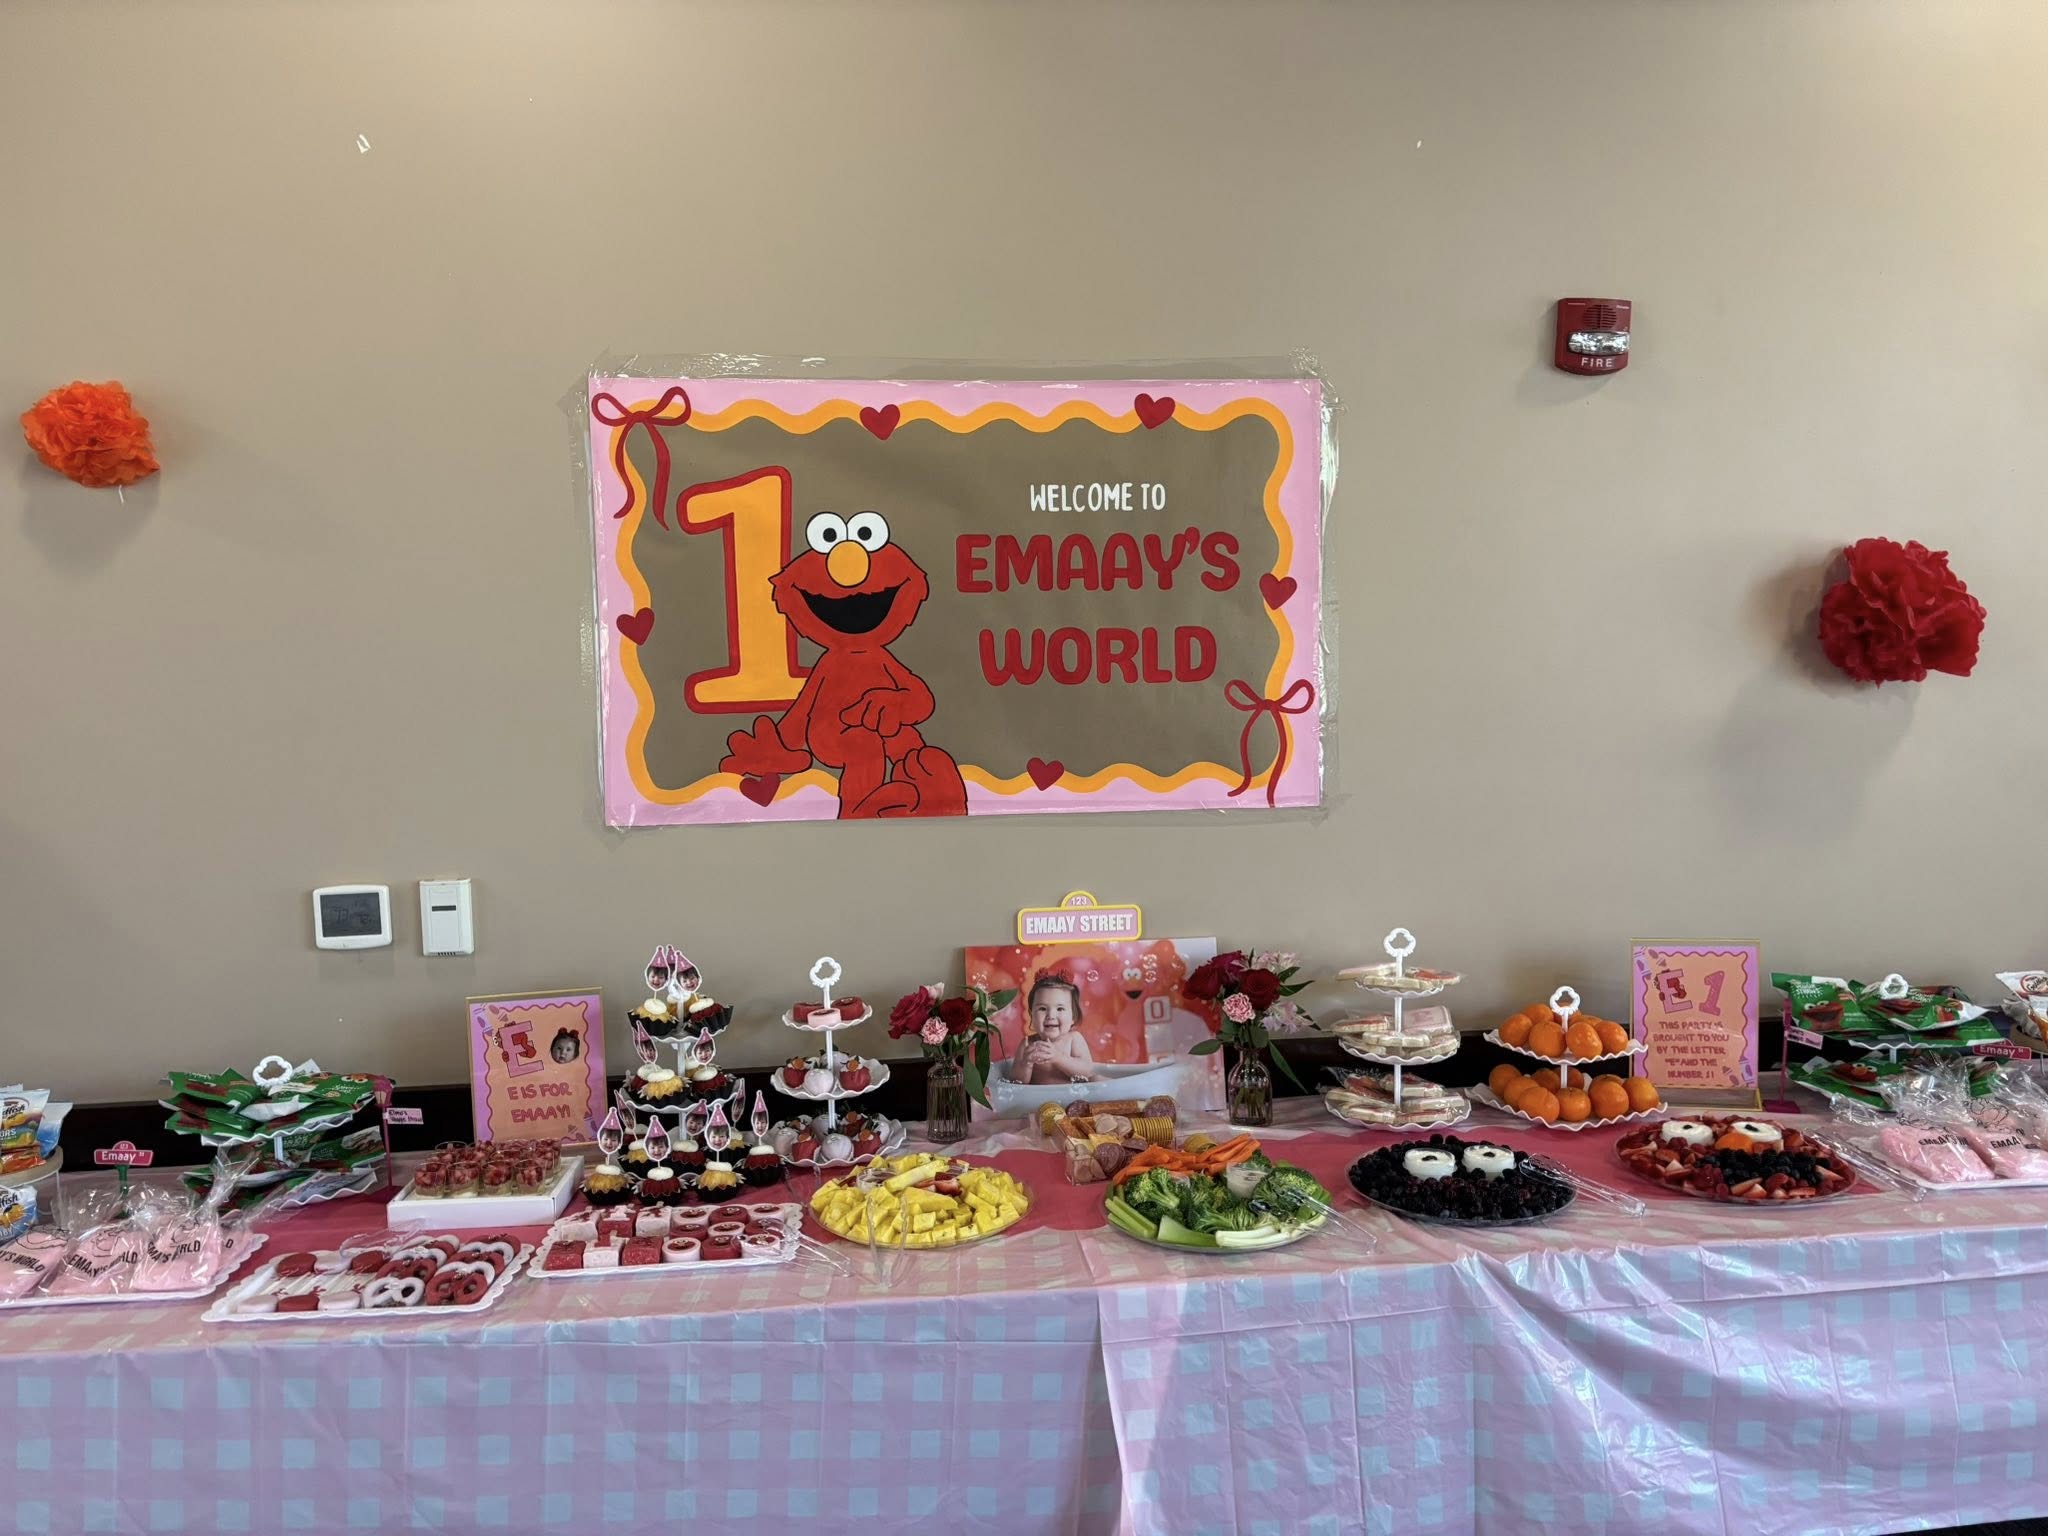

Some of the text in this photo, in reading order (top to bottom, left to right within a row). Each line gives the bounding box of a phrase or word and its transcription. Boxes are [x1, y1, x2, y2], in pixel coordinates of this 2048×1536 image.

[1581, 357, 1613, 368] FIRE
[1030, 482, 1167, 512] WELCOME TO
[955, 526, 1241, 593] EMAAY'S
[978, 626, 1217, 687] WORLD
[1071, 896, 1088, 905] 123
[1026, 914, 1133, 934] EMAAY STREET
[1659, 1021, 1680, 1030] THIS
[1681, 1021, 1713, 1030] PARTY
[1653, 1033, 1729, 1042] BROUGHT TO YOU
[1656, 1046, 1726, 1055] BY THE LETTER
[1979, 1045, 2016, 1059] Emaay
[1680, 1058, 1699, 1067] AND
[1700, 1058, 1718, 1067] THE
[1667, 1070, 1703, 1079] NUMBER
[507, 1082, 573, 1100] E IS FOR
[511, 1104, 571, 1123] EMAAY!
[102, 1151, 136, 1164] Emaay
